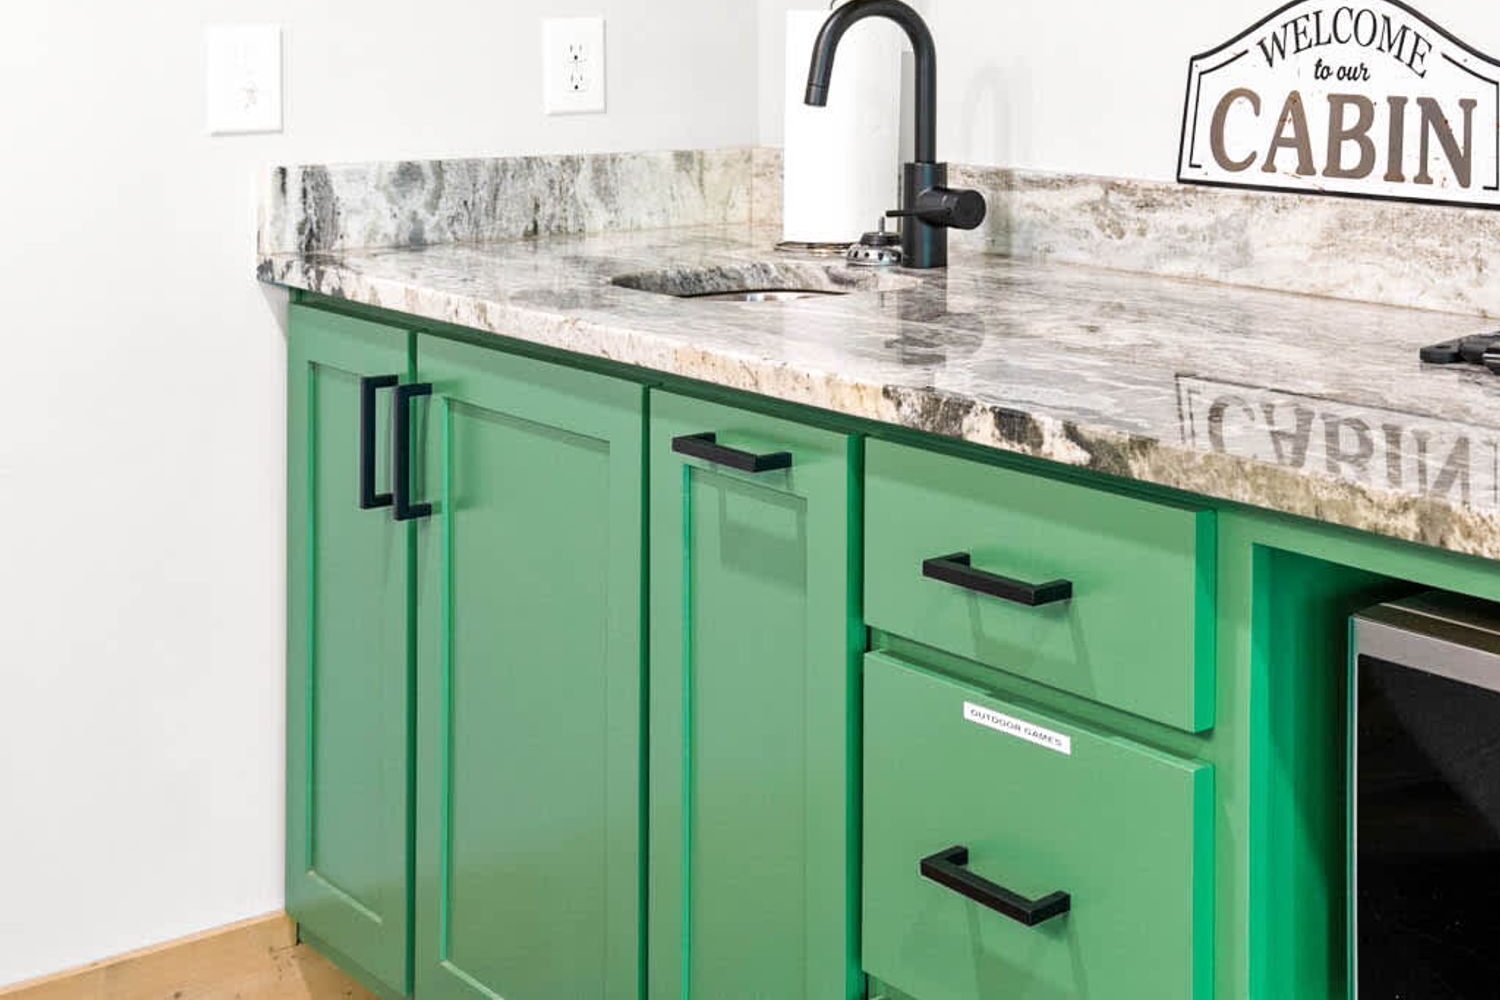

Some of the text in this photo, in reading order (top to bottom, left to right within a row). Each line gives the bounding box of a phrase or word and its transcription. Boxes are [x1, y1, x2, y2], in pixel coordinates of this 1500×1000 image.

[1256, 5, 1433, 79] WELCOME
[1313, 57, 1371, 83] to our
[1208, 86, 1479, 190] CABIN
[969, 708, 1063, 747] OUTDOOR GAMES
